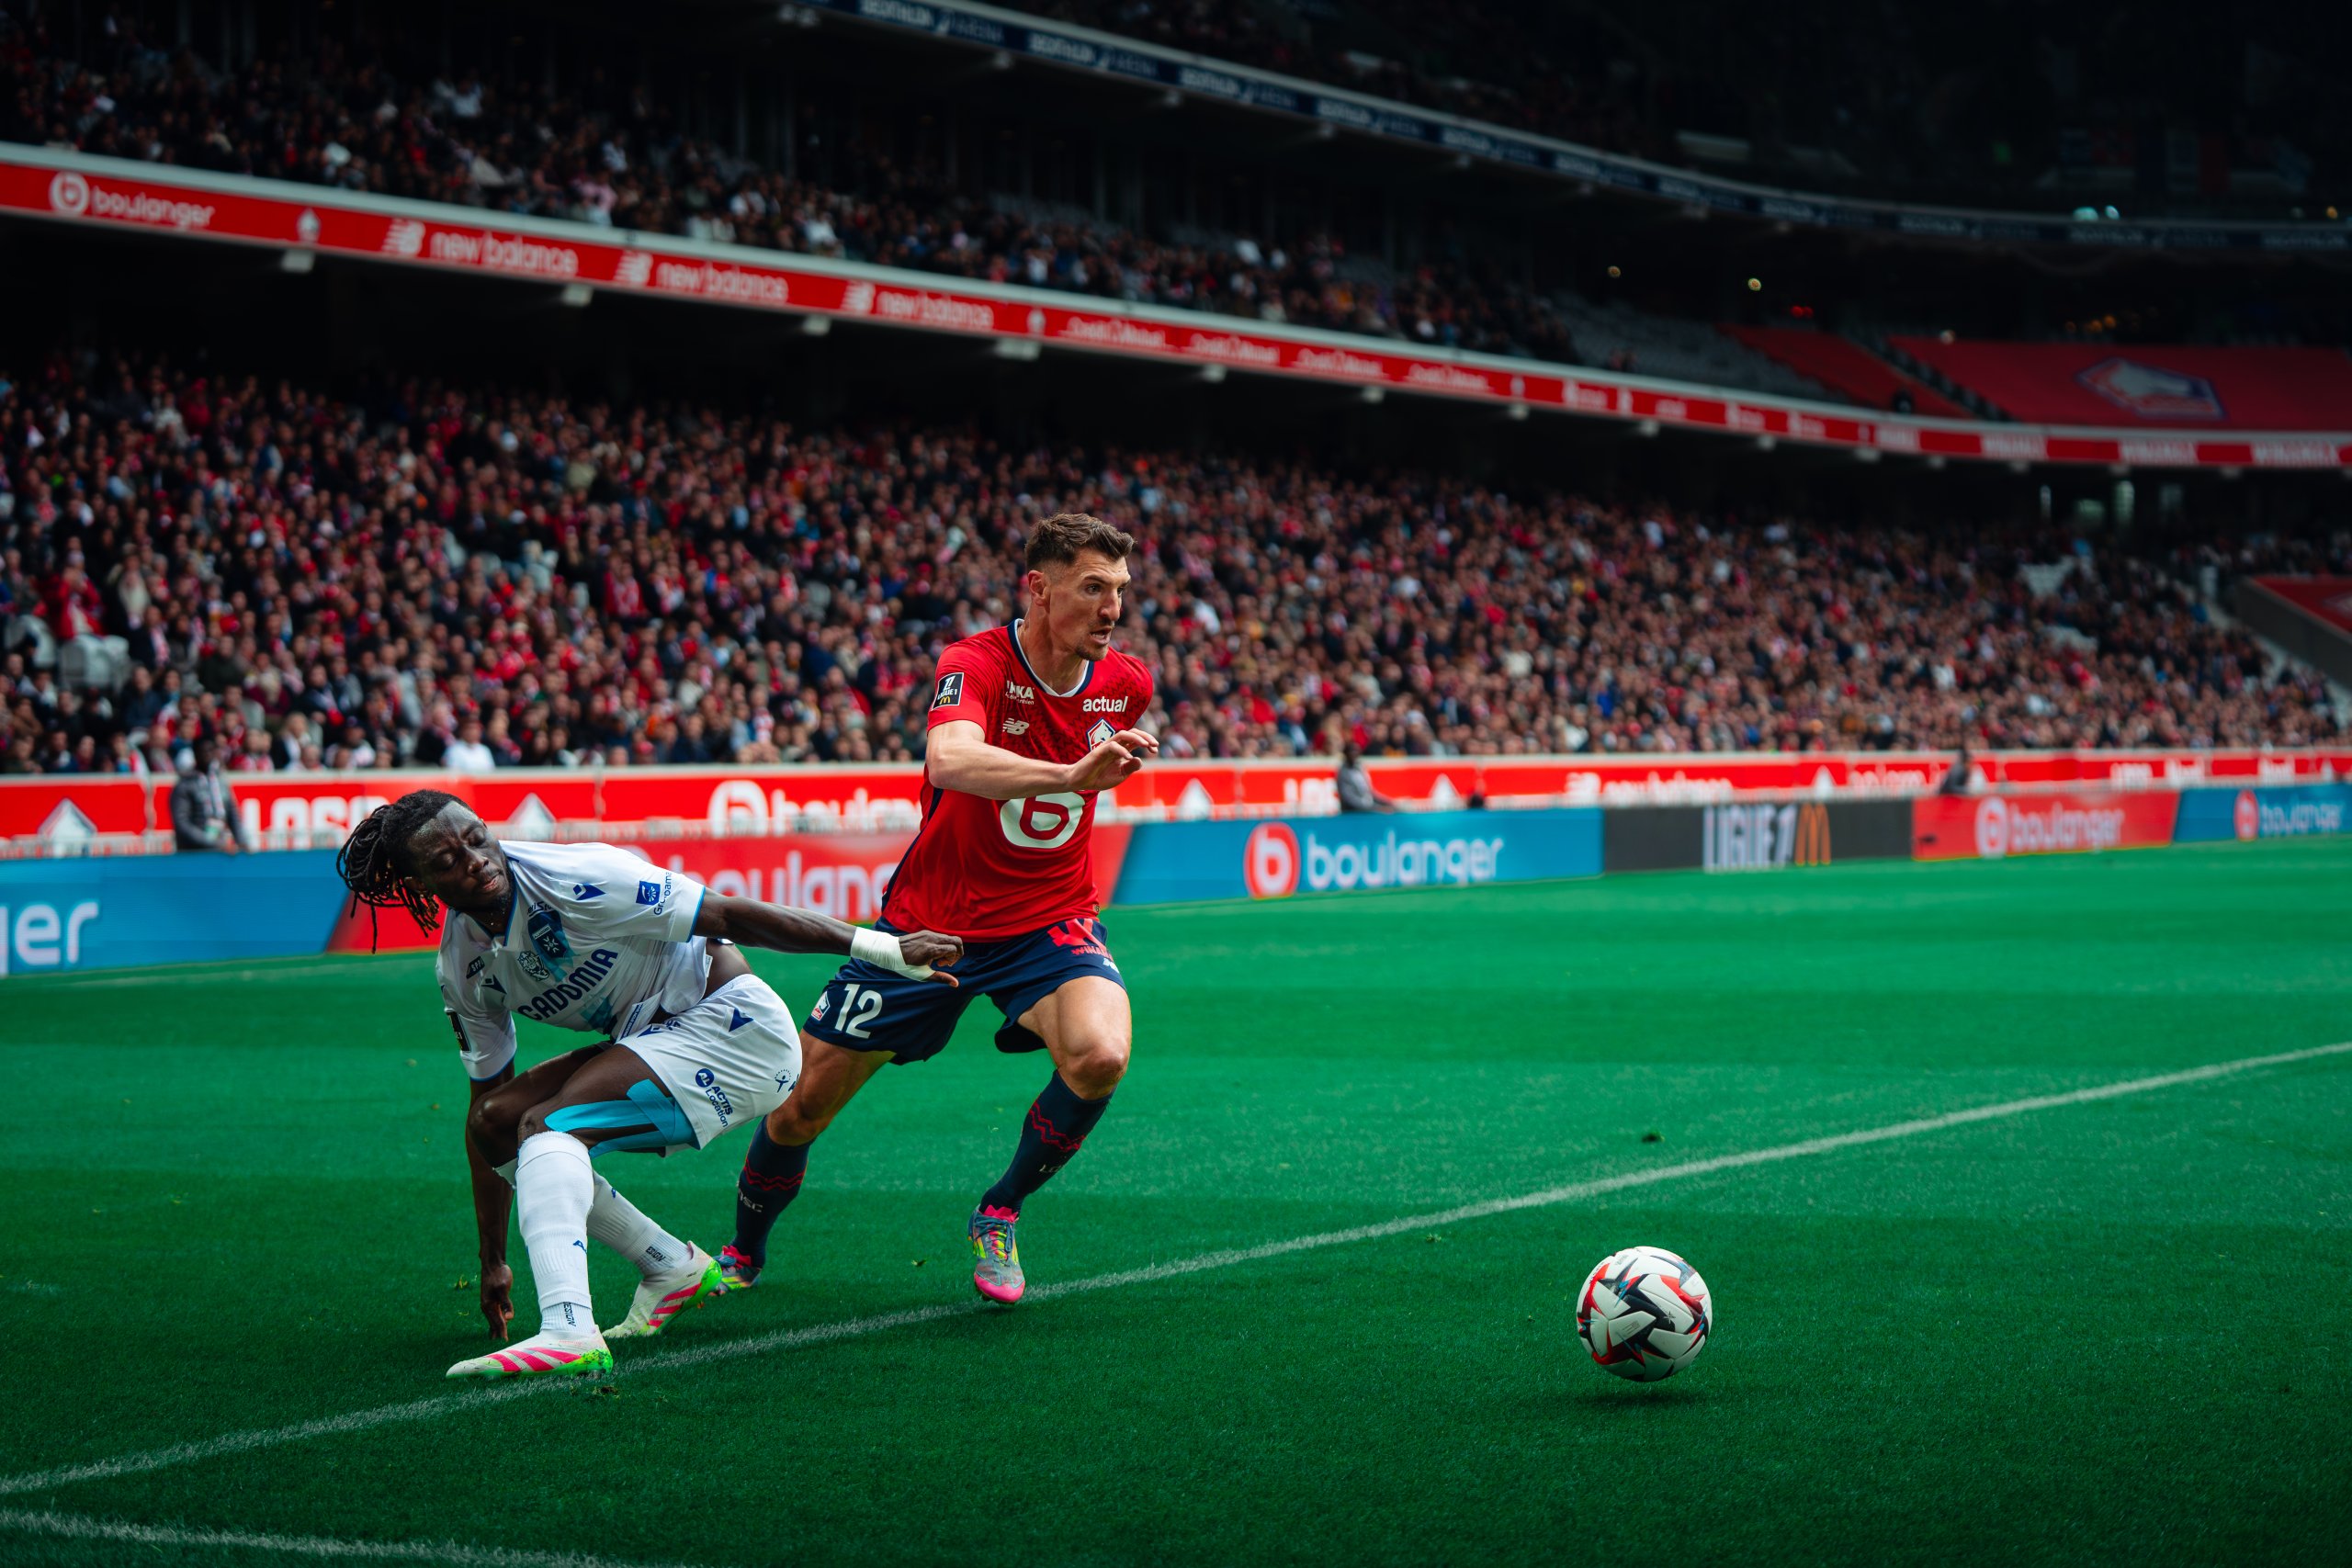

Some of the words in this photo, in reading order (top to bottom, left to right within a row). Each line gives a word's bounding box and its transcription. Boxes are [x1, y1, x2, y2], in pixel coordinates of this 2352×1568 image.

[94, 186, 215, 231] boulanger
[1082, 695, 1129, 713] actual
[1307, 830, 1503, 888] boulanger
[653, 872, 673, 915] Grpam
[517, 948, 618, 1021] CADOMIA
[834, 983, 883, 1039] 12
[706, 1089, 729, 1128] Location
[711, 1086, 733, 1115] ACTIS
[563, 1302, 577, 1327] ESIGN
